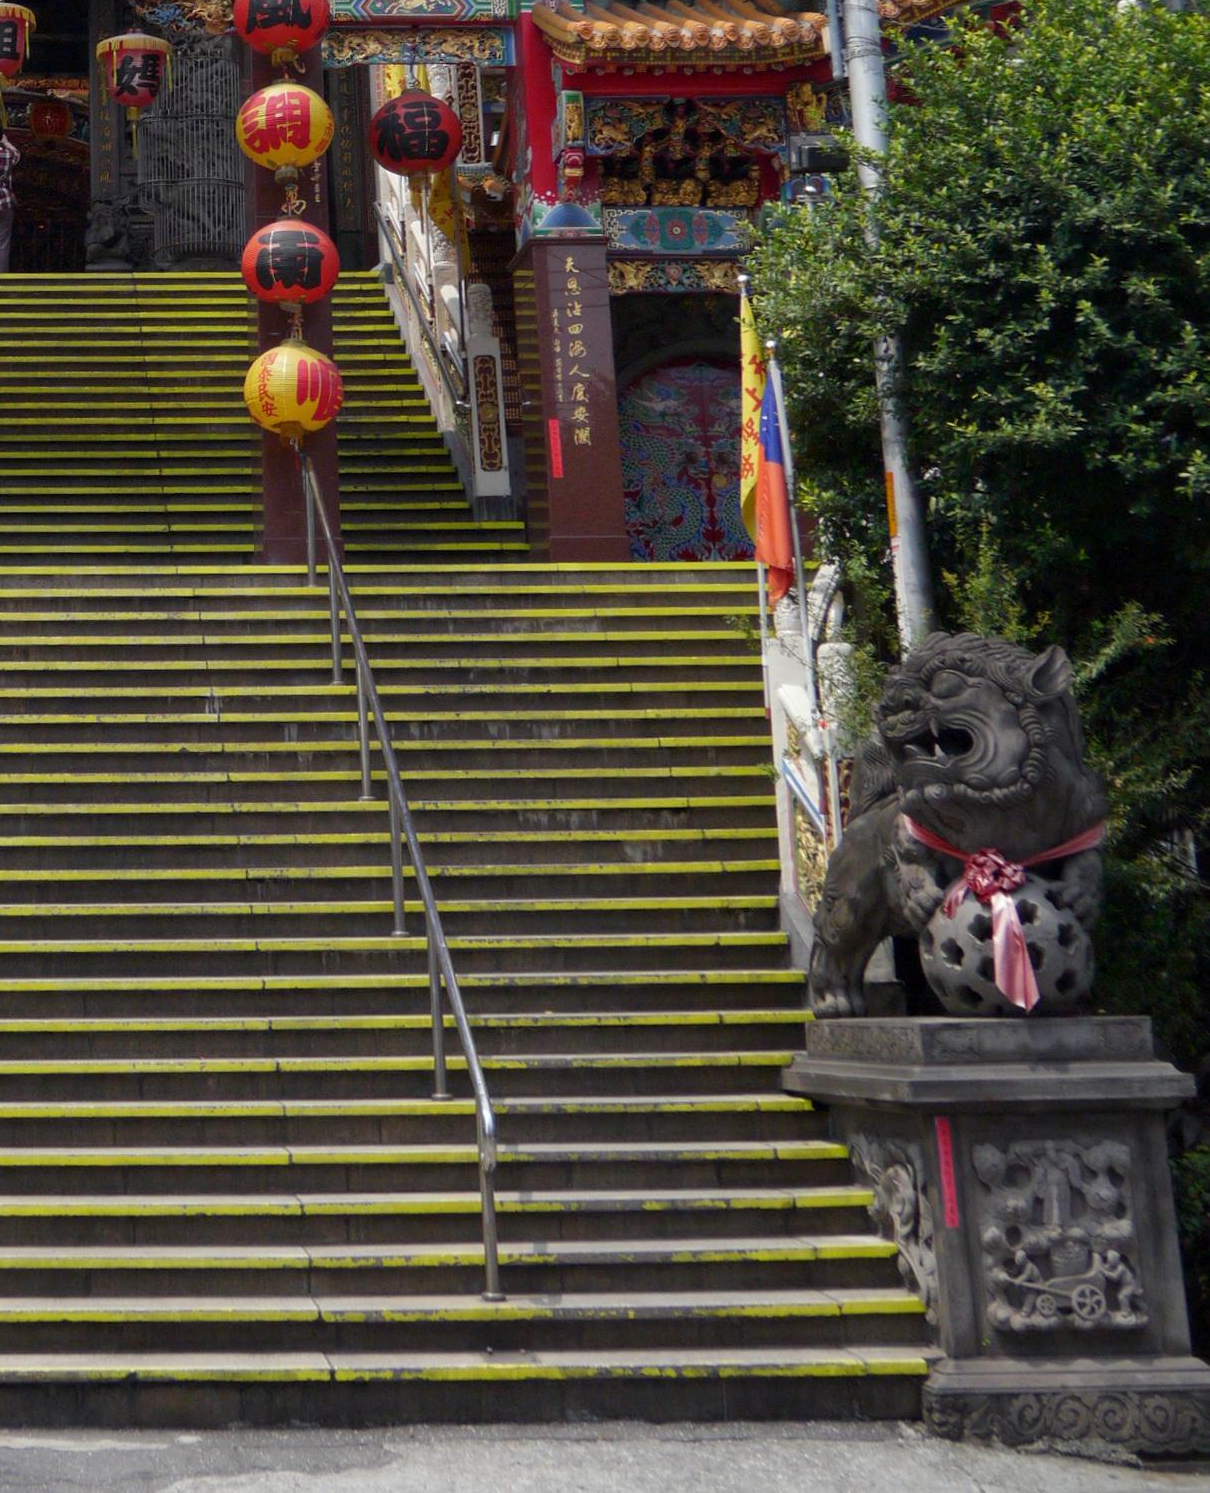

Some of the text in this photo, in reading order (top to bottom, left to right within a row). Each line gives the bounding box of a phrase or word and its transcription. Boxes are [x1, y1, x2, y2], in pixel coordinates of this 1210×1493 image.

[115, 54, 160, 97] 媽
[241, 91, 311, 154] 調
[375, 101, 450, 161] 福
[256, 230, 324, 290] 雨
[258, 352, 280, 418] 國泰民安
